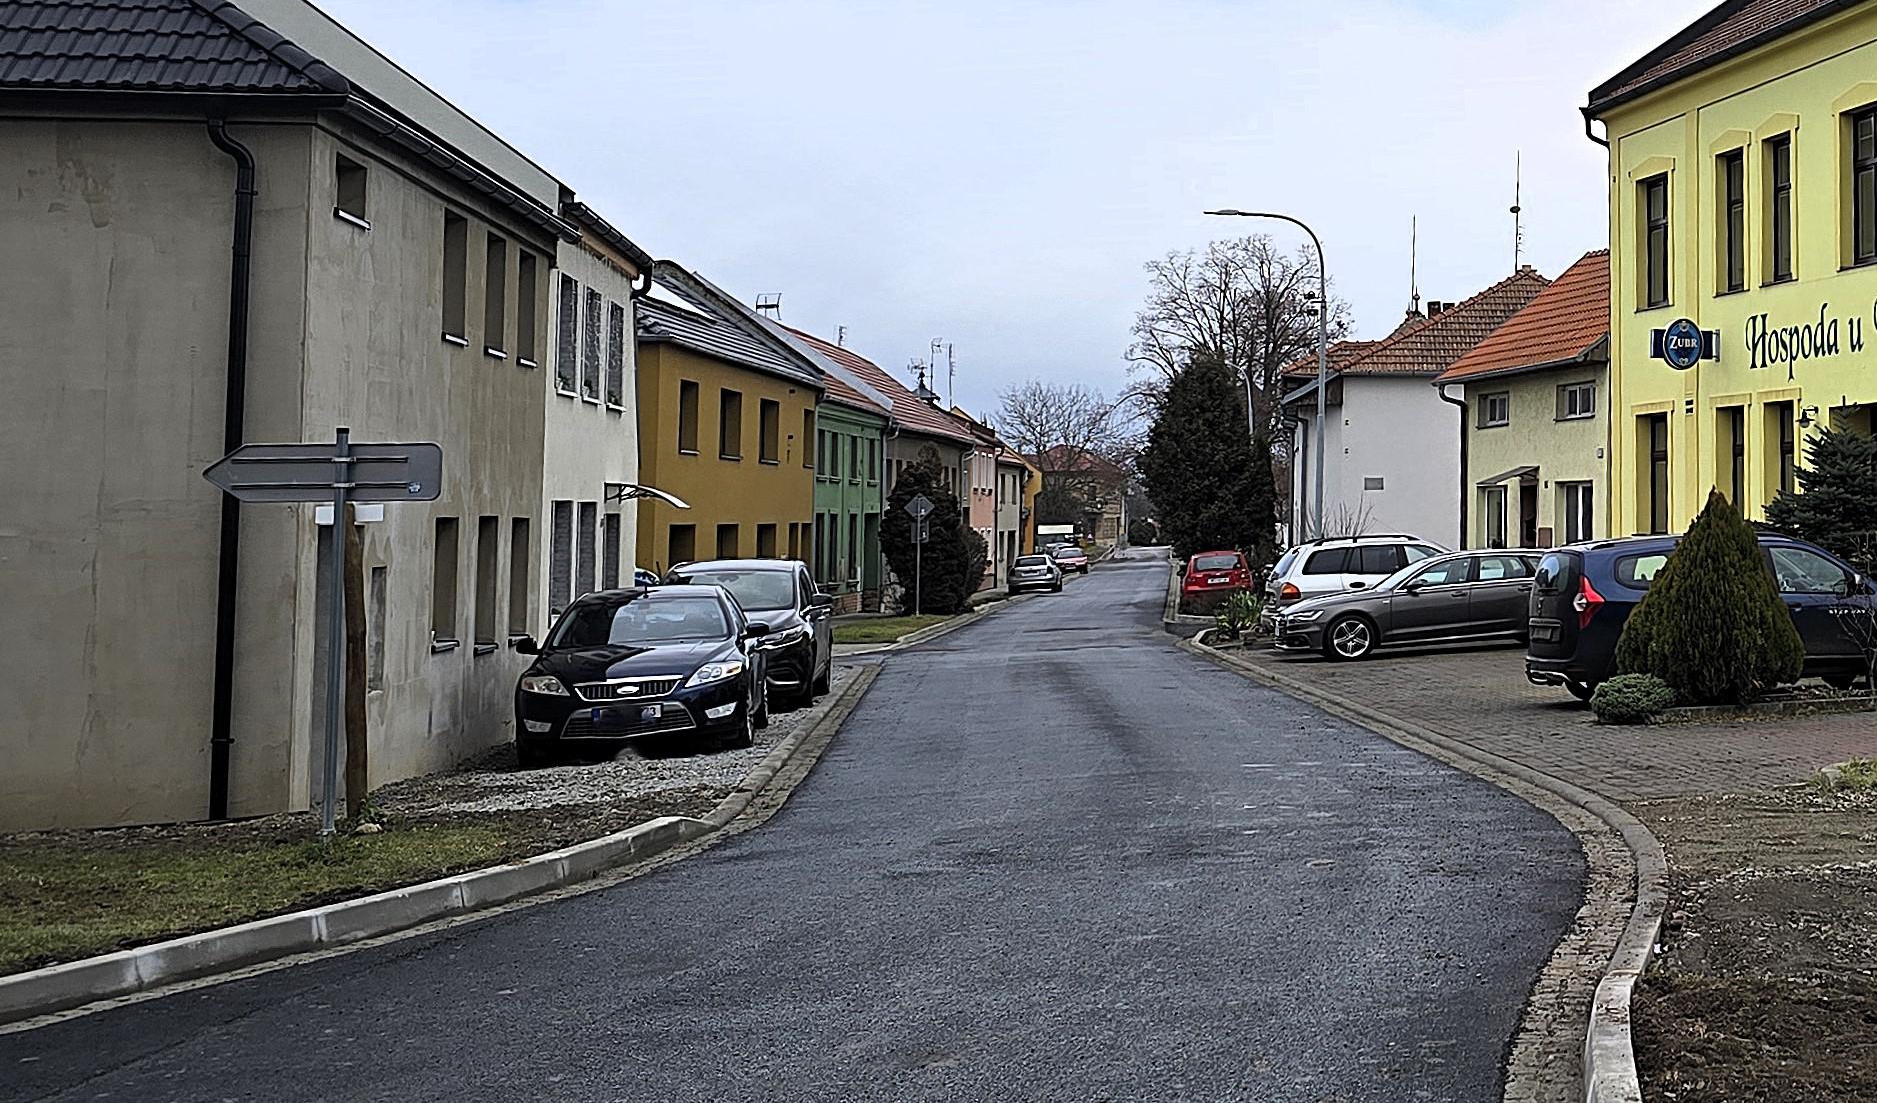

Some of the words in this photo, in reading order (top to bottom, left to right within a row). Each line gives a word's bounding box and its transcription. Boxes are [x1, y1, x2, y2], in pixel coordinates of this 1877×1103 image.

[1669, 335, 1698, 350] ZUBR
[1745, 303, 1840, 383] Hospoda
[1848, 316, 1865, 353] u
